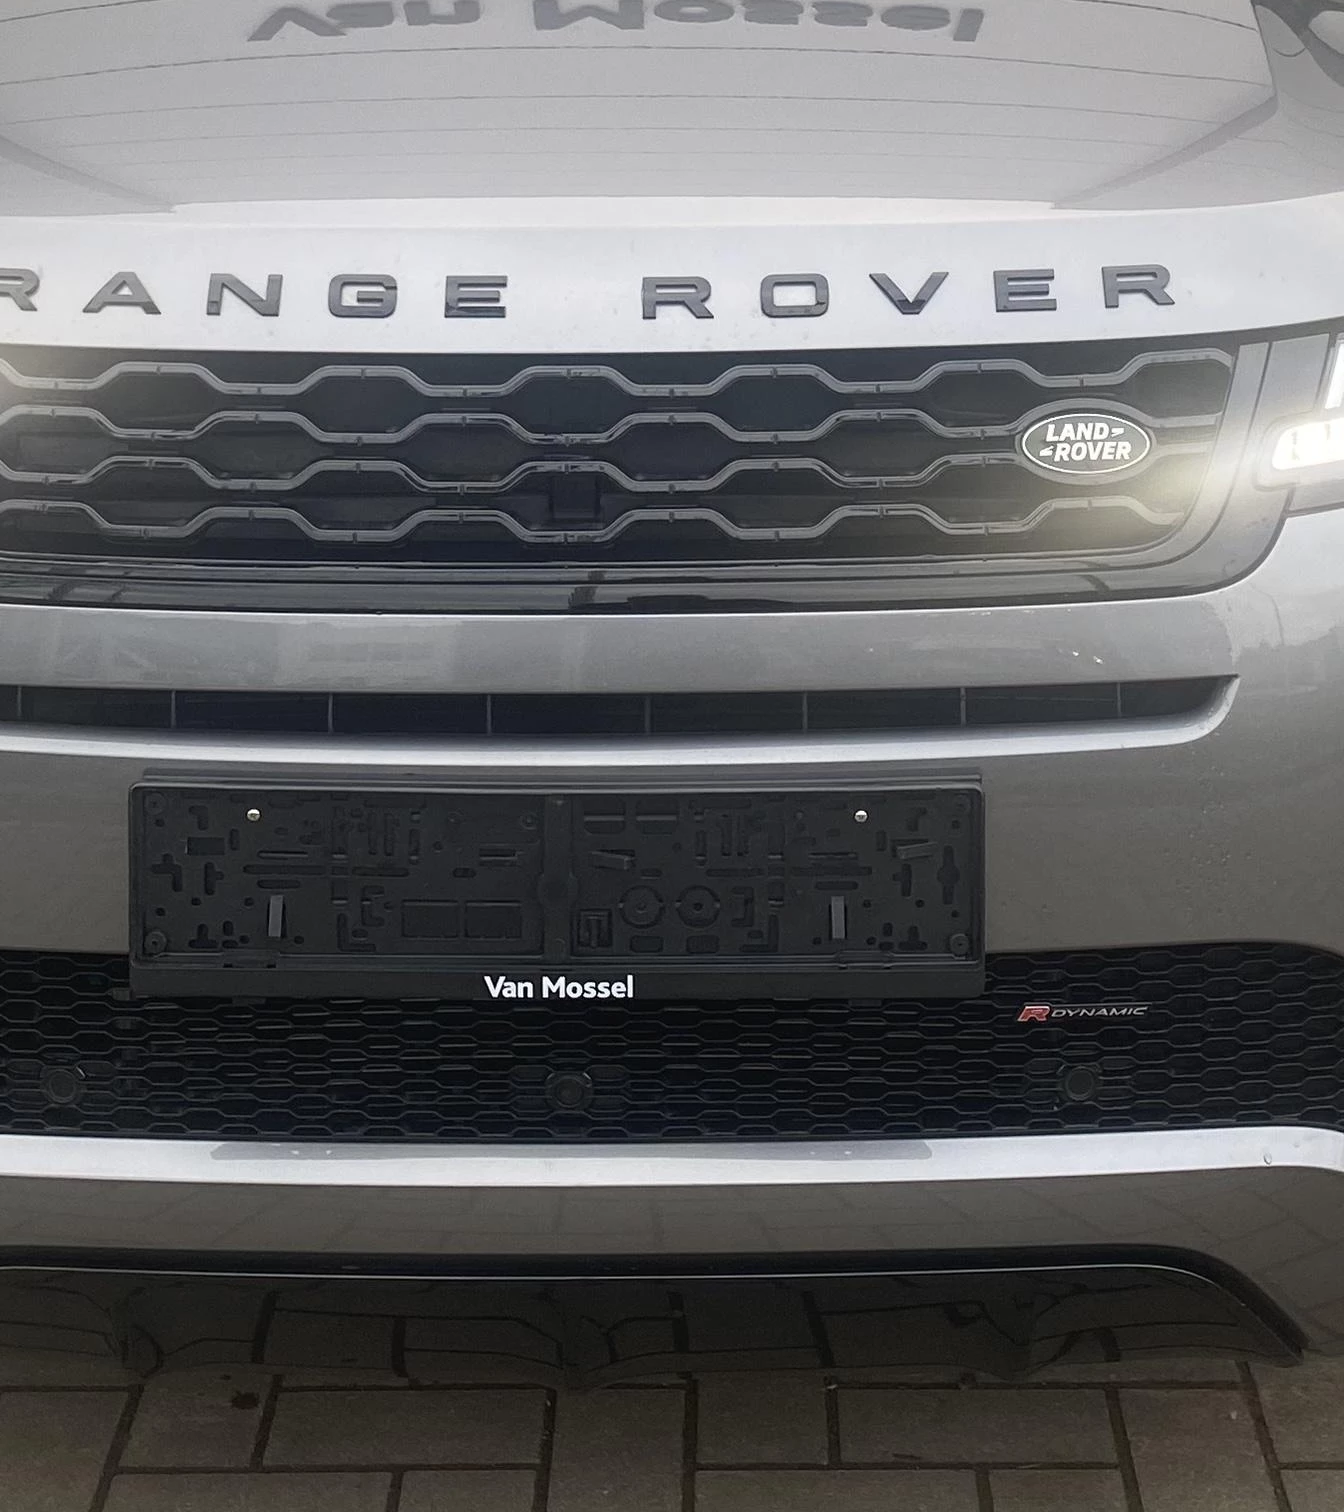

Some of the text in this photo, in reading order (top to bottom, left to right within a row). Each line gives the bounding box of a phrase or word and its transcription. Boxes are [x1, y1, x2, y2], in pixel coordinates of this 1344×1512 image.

[642, 263, 1175, 319] ROVER
[1045, 422, 1109, 442] LAND
[1053, 441, 1133, 462] ROVER
[484, 974, 634, 999] Van Mossel
